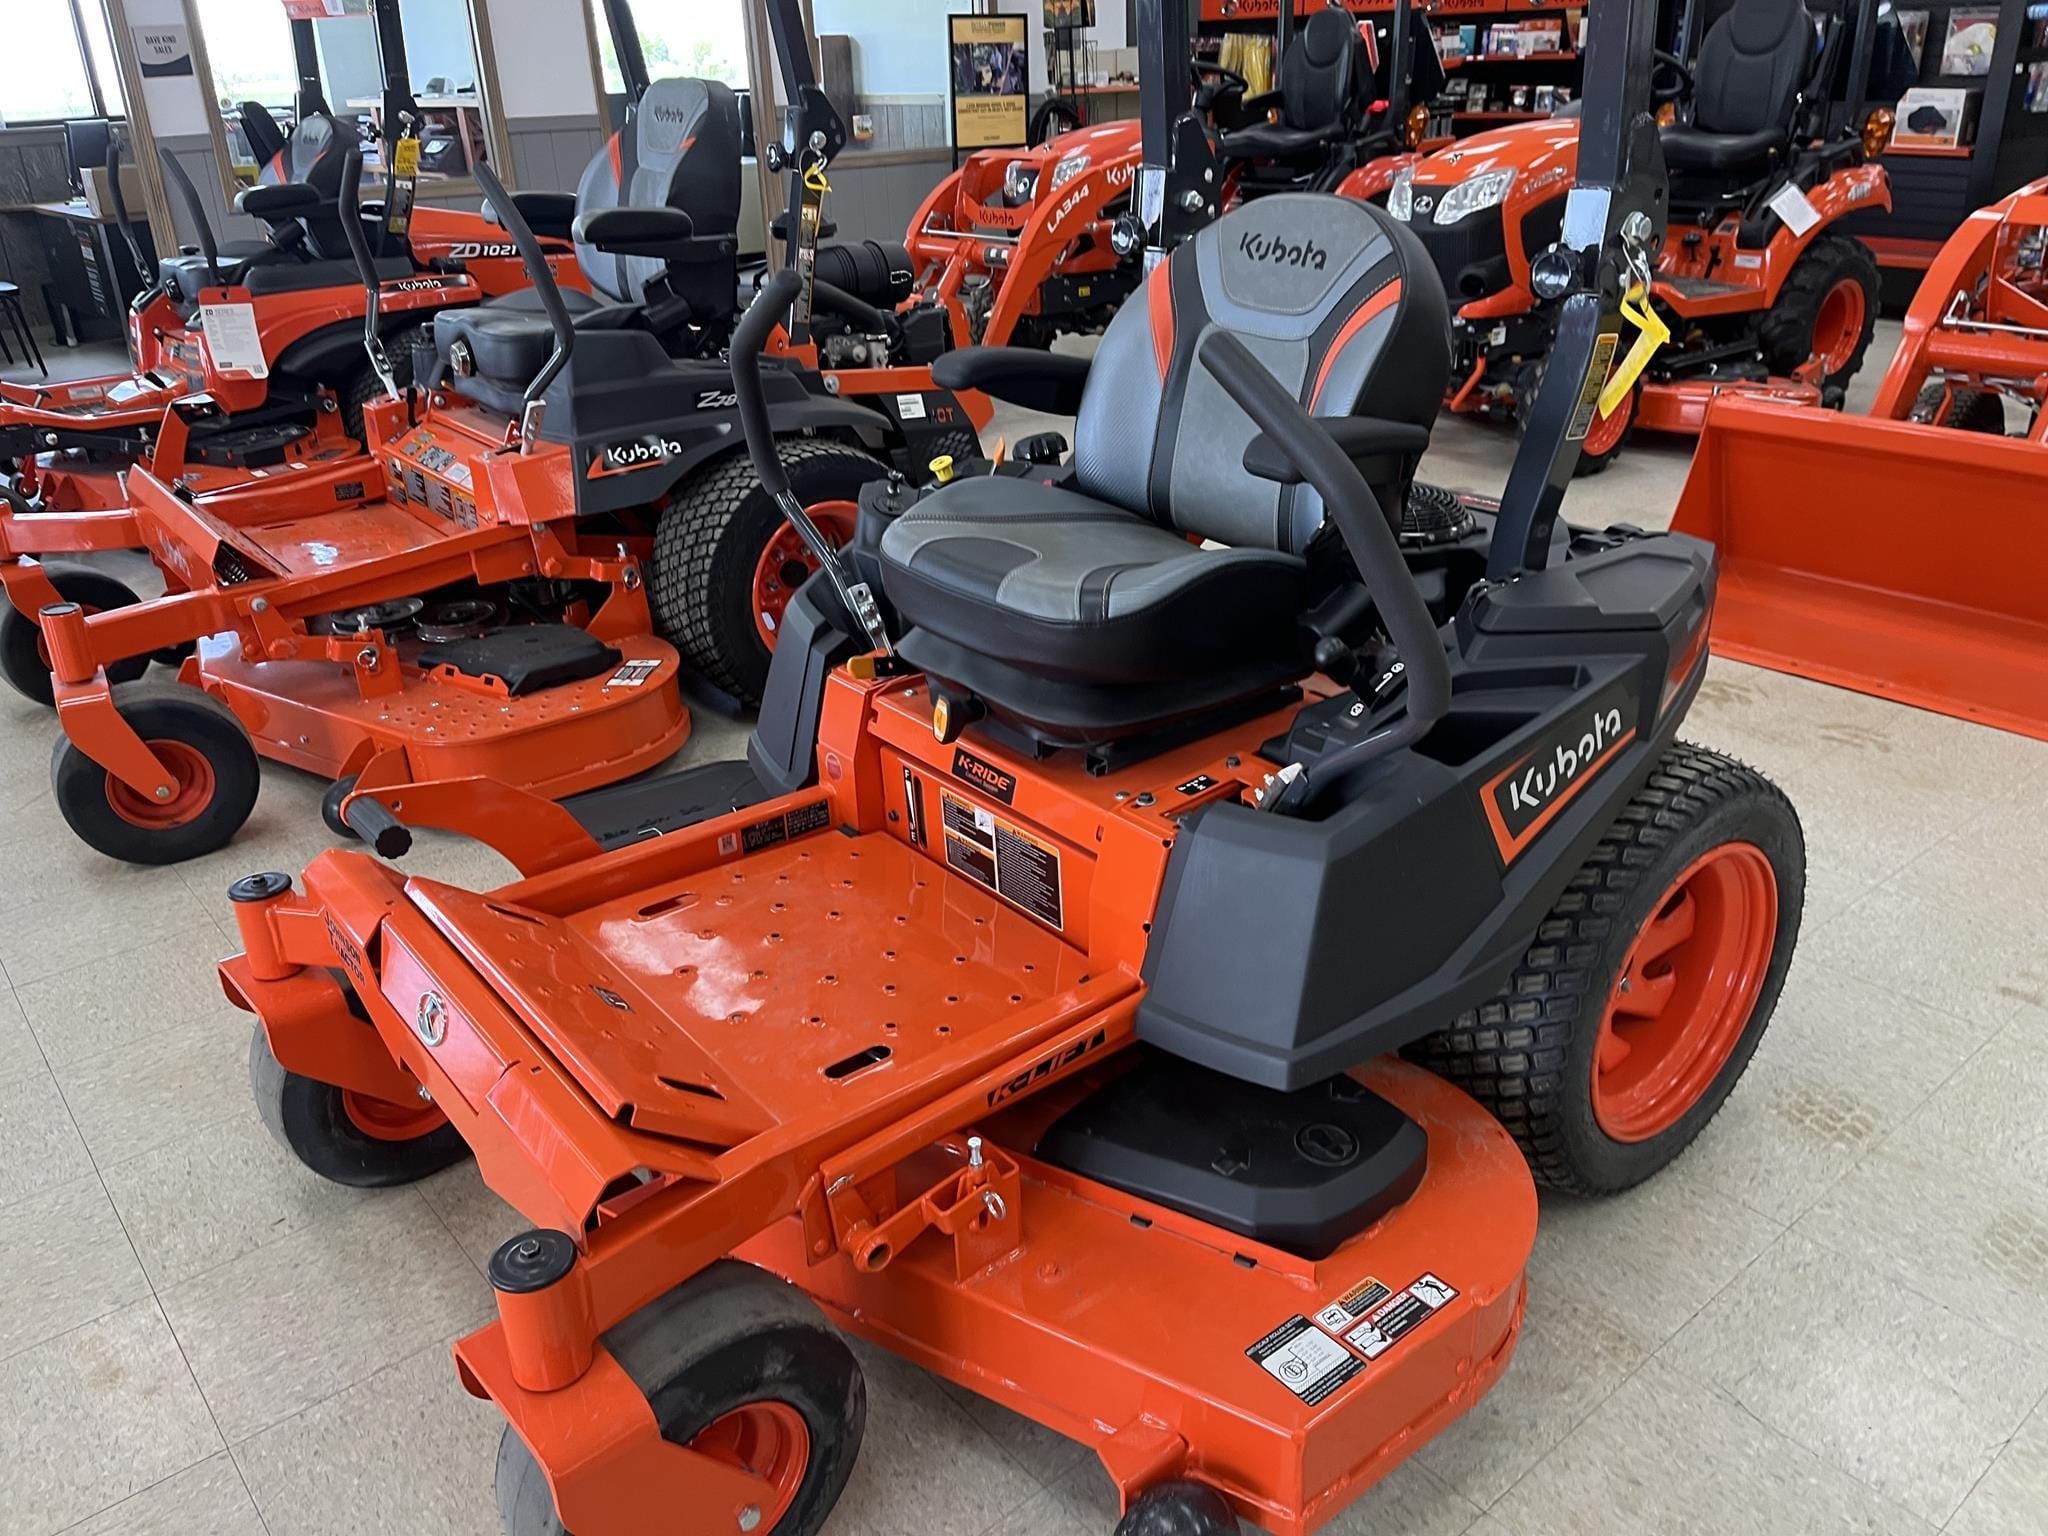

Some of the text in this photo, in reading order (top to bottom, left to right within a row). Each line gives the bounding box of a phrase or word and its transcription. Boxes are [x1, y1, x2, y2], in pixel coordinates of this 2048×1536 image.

[979, 210, 1014, 227] Kubota
[1047, 184, 1090, 233] LA344
[1239, 231, 1327, 271] Kubota
[398, 278, 442, 292] Kubota
[607, 438, 682, 464] Kubota
[958, 754, 1012, 792] K-RIDE
[1509, 708, 1622, 812] Kubota
[988, 1030, 1105, 1108] K-LIFT
[1377, 1291, 1410, 1318] DANGER
